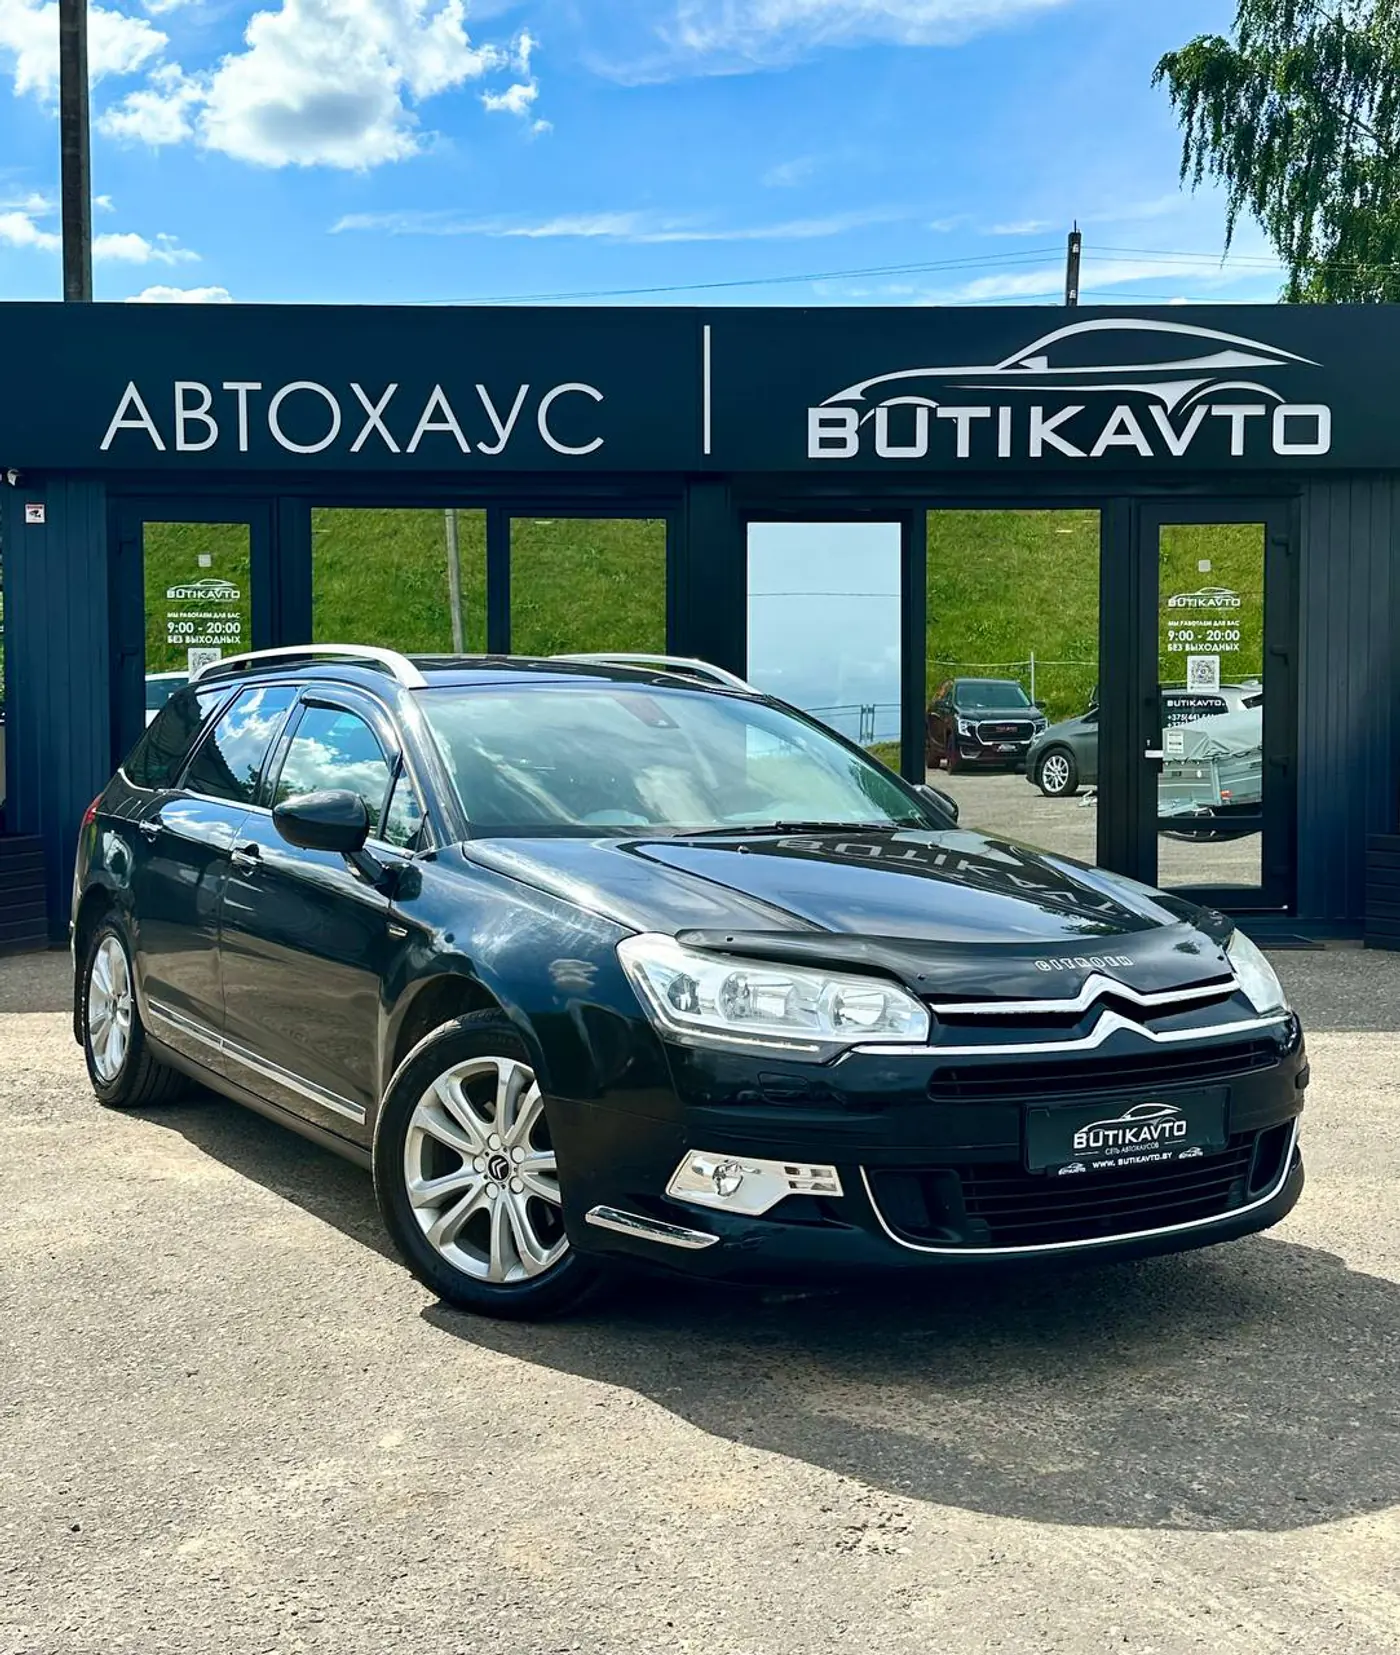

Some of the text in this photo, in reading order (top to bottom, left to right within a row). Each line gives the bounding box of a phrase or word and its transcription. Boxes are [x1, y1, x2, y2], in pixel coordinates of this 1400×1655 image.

[100, 381, 604, 455] АВТОХАУС
[807, 404, 1332, 458] BUTIKAVTO
[166, 590, 241, 599] BUTIKAVTO
[1168, 598, 1241, 607] BUTIKAVTO
[167, 622, 194, 633] 9:00
[206, 622, 241, 633] 20:00
[167, 635, 241, 644] БЕЗ ВЫХОДНЫХ
[1168, 630, 1194, 641] 9:00
[1206, 630, 1240, 641] 20:00
[1167, 643, 1240, 652] БЕЗ ВЫХОДНЫХ
[1034, 955, 1134, 971] CITROEN
[1073, 1120, 1188, 1149] BUTIKAVTO
[1104, 1147, 1121, 1156] СЕТЬ
